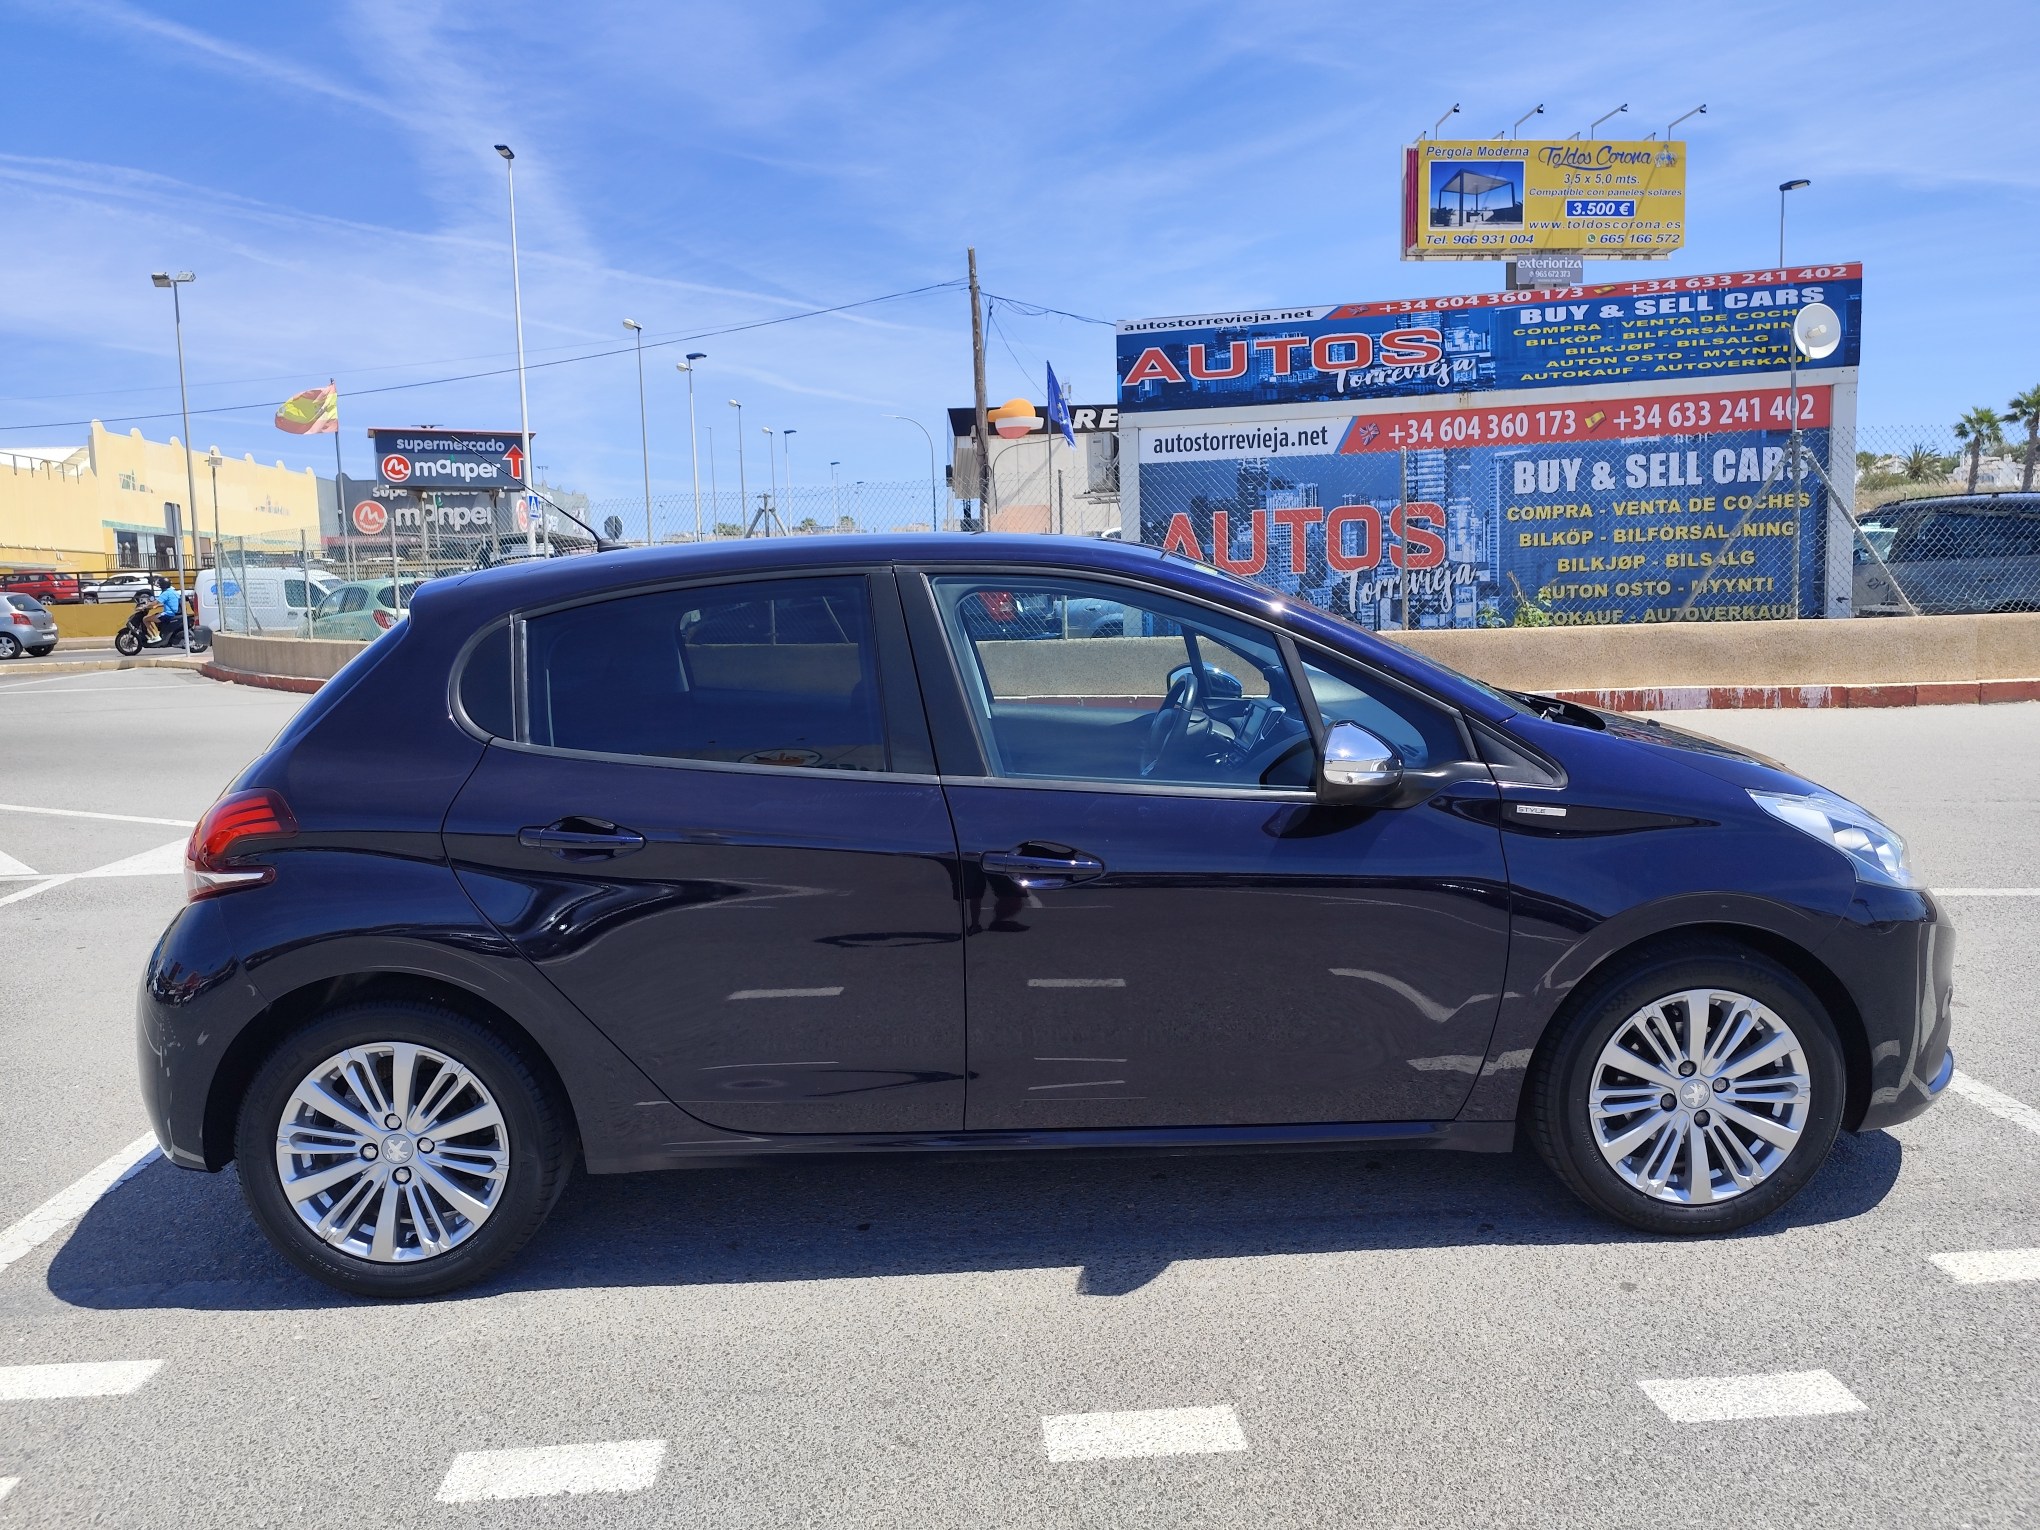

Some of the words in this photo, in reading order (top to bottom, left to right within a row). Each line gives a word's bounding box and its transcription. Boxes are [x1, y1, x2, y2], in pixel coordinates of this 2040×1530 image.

[1477, 146, 1529, 157] Moderna
[1538, 146, 1592, 168] Toldos
[1596, 145, 1652, 165] Corona
[1563, 174, 1581, 185] 3,5
[1584, 175, 1591, 184] x
[1595, 174, 1612, 185] 5,0
[1615, 174, 1640, 184] mts.
[1529, 188, 1583, 197] Compatible
[1607, 188, 1645, 197] paneles
[1647, 188, 1682, 196] solares
[1572, 202, 1615, 215] 3.500
[1619, 202, 1631, 215] €
[1529, 220, 1681, 229] www.toldoscorona.es
[1425, 235, 1448, 244] Tel.
[1453, 235, 1477, 244] 966
[1481, 235, 1505, 244] 931
[1509, 234, 1534, 244] 004
[1600, 234, 1624, 244] 665
[1630, 234, 1652, 244] 166
[1656, 234, 1680, 244] 572
[1517, 257, 1582, 269] exterioriza
[1624, 280, 1678, 293] +34
[1685, 275, 1732, 288] 633
[1741, 271, 1788, 284] 241
[1798, 266, 1847, 280] 402
[1379, 300, 1429, 313] +34
[1435, 294, 1480, 308] 604
[1486, 291, 1532, 305] 360
[1540, 286, 1584, 300] 173
[1520, 304, 1590, 324] BUY
[1599, 304, 1624, 319] &
[1634, 295, 1714, 316] SELL
[1724, 287, 1825, 309] CARS
[1124, 309, 1314, 331] autostorrevieja.net
[1513, 323, 1600, 336] COMPRA
[1621, 316, 1692, 328] VENTA
[1700, 313, 1729, 323] DE
[1735, 308, 1798, 320] COCH
[1525, 334, 1602, 347] BILKÖP
[1622, 321, 1793, 340] BILFÖRSÄLJNIN
[1565, 342, 1656, 356] BILKJØP
[1677, 334, 1769, 348] BILSALG
[1122, 328, 1443, 386] AUTOS
[1546, 355, 1618, 368] AUTON
[1625, 352, 1683, 363] OSTO
[1703, 344, 1789, 358] MYYNTI
[1329, 358, 1474, 393] Torrevieja
[1520, 367, 1634, 381] AUTOKAUF
[1613, 404, 1661, 431] +34
[1668, 400, 1711, 428] 633
[1719, 396, 1761, 424] 241
[1769, 393, 1814, 421] 402
[1388, 418, 1434, 444] +34
[1440, 415, 1480, 442] 604
[1487, 412, 1528, 439] 360
[1535, 409, 1576, 436] 173
[396, 438, 505, 453] supermercado
[1153, 425, 1329, 453] autostorrevieja.net
[414, 459, 501, 482] manper
[1514, 458, 1582, 494] BUY
[1591, 461, 1616, 491] &
[1625, 451, 1703, 489] SELL
[1507, 503, 1593, 521] COMPRA
[1612, 499, 1682, 516] VENTA
[1689, 496, 1716, 513] DE
[1163, 502, 1446, 576] AUTOS
[1519, 528, 1594, 547] BILKÖP
[1613, 520, 1794, 543] BILFÖRSÄLNING
[1557, 554, 1645, 573] BILKJØP
[1342, 560, 1477, 614] Torrvieja
[1615, 581, 1671, 597] OSTO
[1514, 609, 1624, 626] ATOKAUF
[1518, 806, 1546, 814] STYLE
